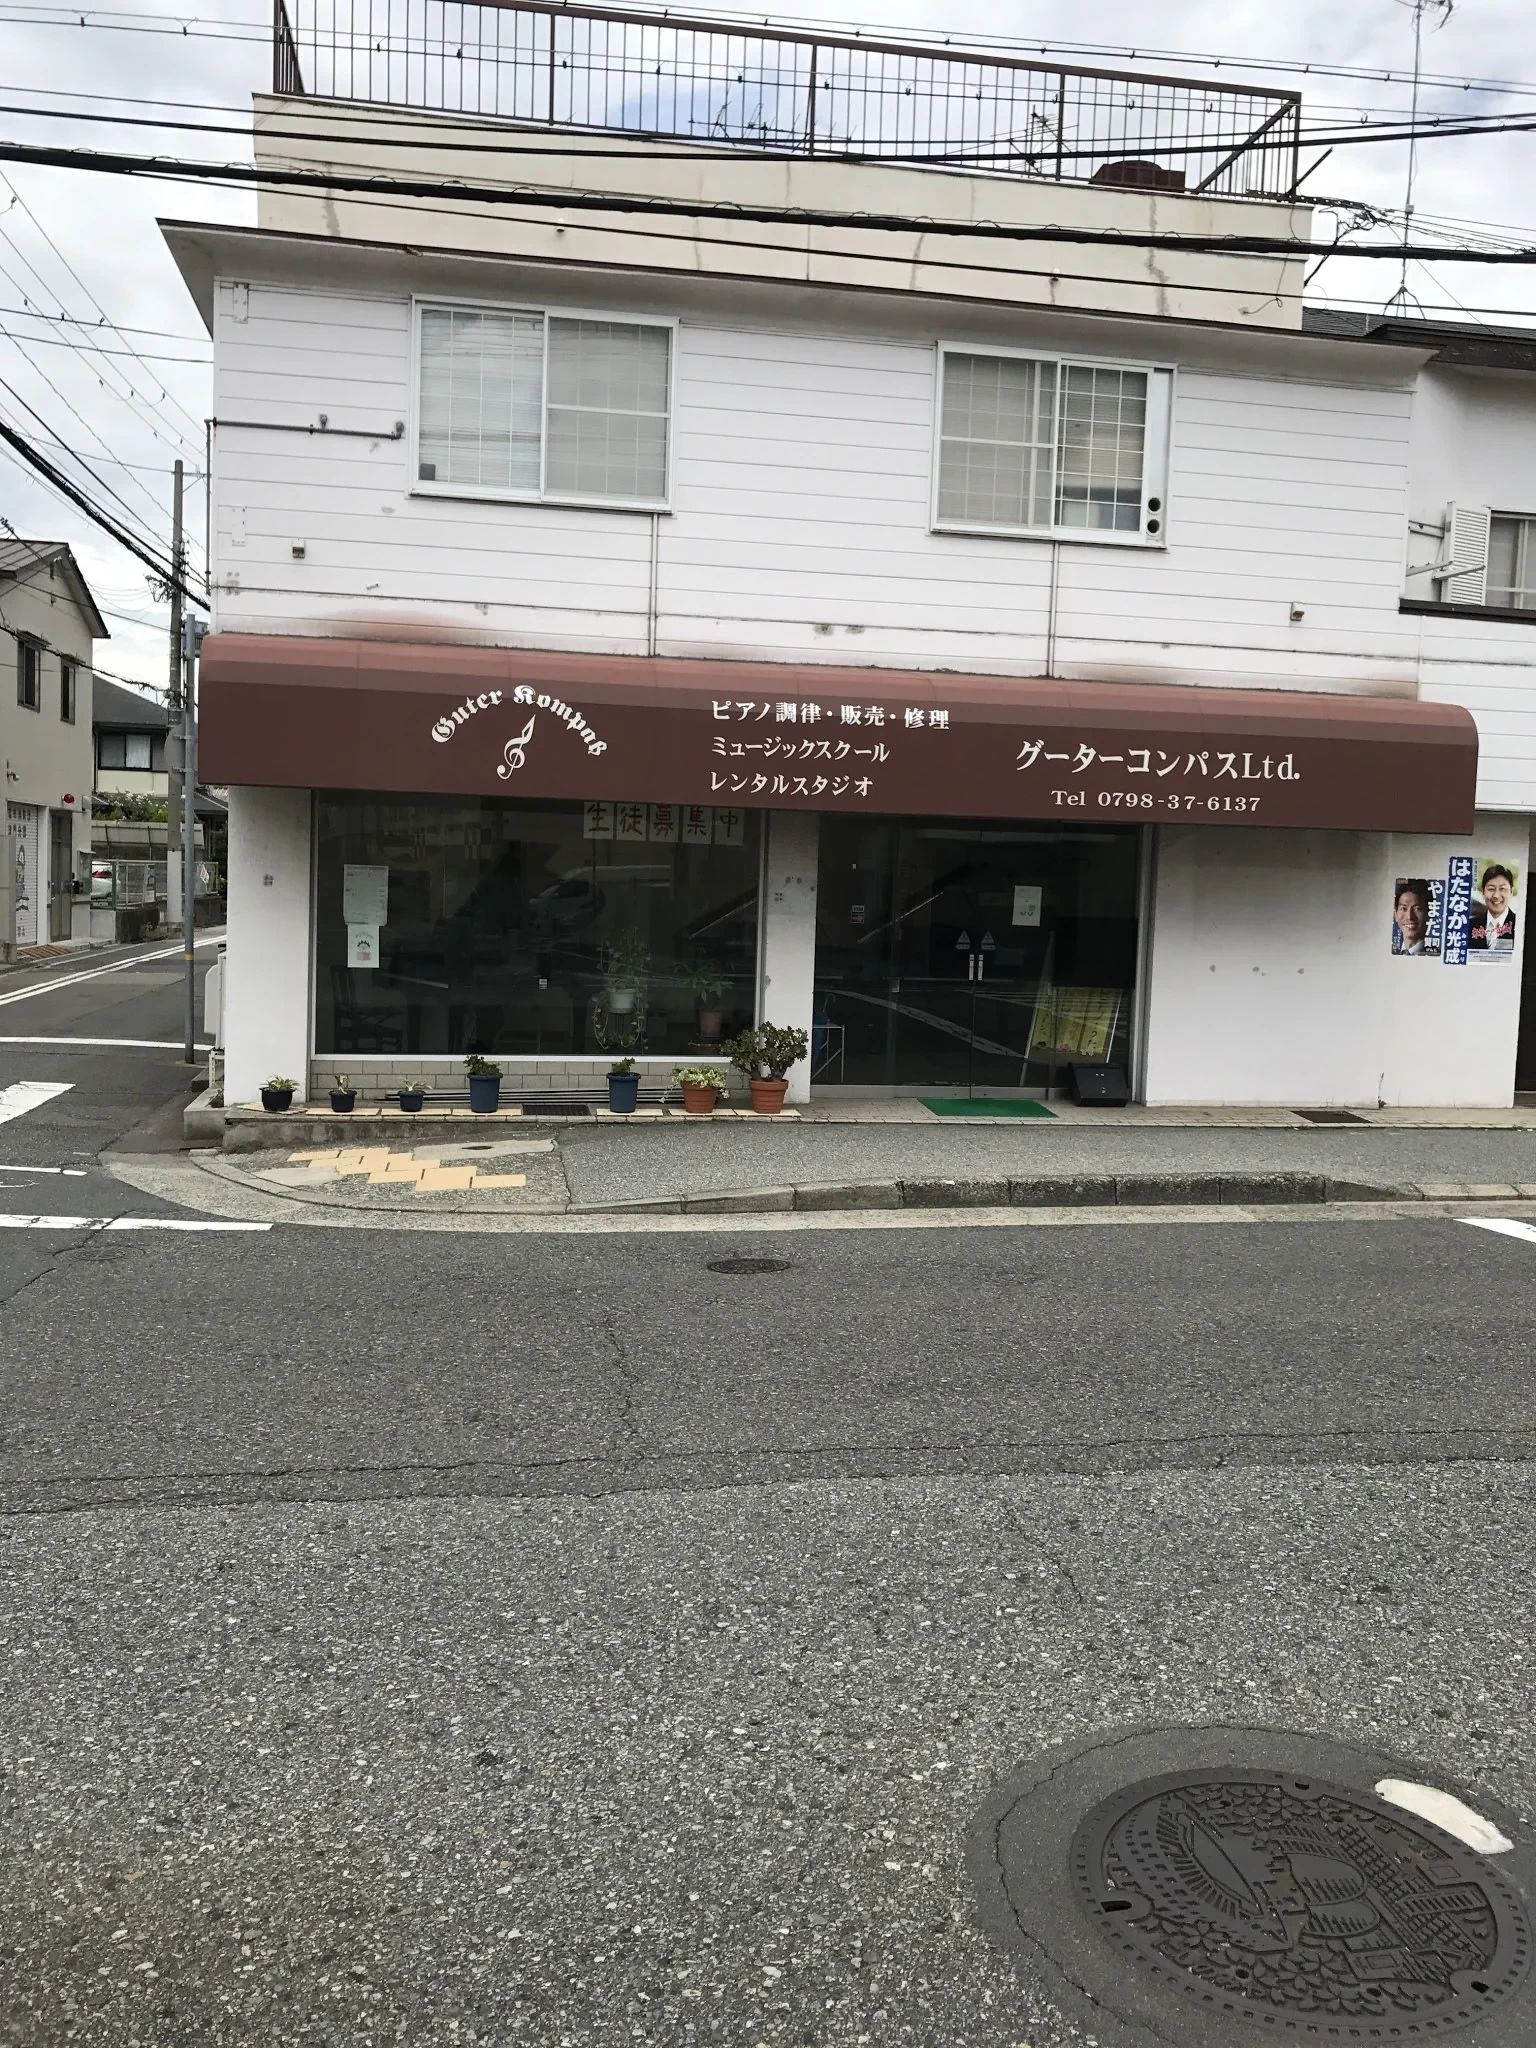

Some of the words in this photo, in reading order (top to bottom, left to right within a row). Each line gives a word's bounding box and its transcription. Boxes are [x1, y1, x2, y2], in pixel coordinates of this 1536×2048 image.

[431, 689, 503, 743] Guter
[711, 700, 950, 730] ピアノ調律・販売・修理
[711, 736, 890, 764] ミュージックスクール
[1016, 739, 1301, 781] グーターコンパスLtd.
[709, 771, 873, 797] レンタルスタジオ
[1051, 790, 1086, 807] Tel
[1097, 791, 1261, 813] 0798-37-6137
[1425, 881, 1442, 936] やまだ
